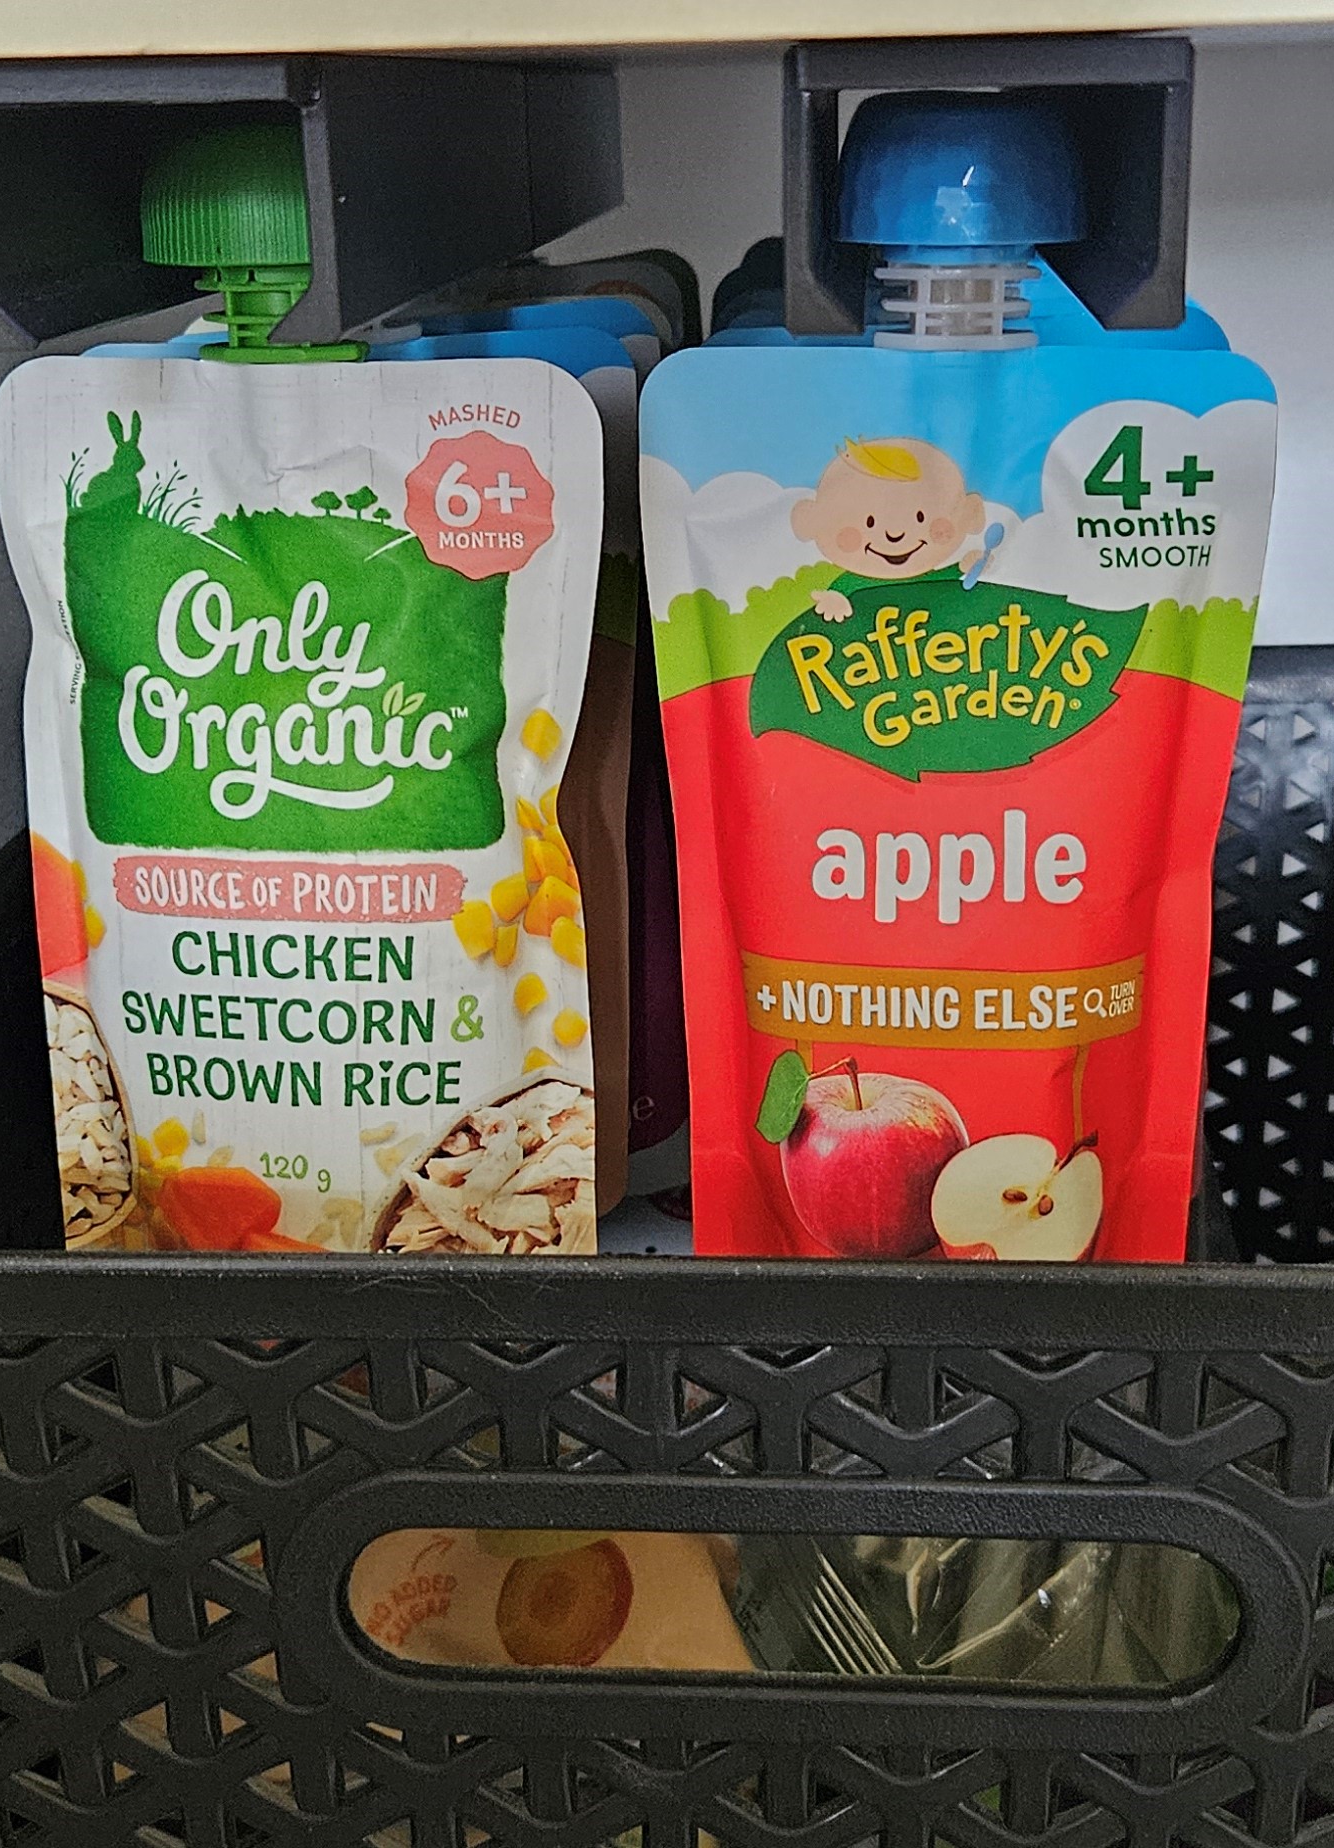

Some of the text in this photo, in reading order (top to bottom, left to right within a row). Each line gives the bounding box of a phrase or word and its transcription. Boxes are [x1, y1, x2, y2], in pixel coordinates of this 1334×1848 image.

[428, 403, 521, 431] MASHED
[1083, 425, 1214, 510] 4+
[435, 460, 528, 528] 6+
[438, 531, 524, 550] MONTHS
[1077, 508, 1217, 539] months
[1099, 544, 1211, 569] SMOOTH
[157, 569, 386, 708] Only
[785, 603, 1110, 715] Rafferty's
[70, 662, 82, 705] SERVING
[812, 809, 1087, 924] apple
[134, 865, 438, 915] SOURCE OF PROTEIN
[171, 930, 415, 983] CHICKEN
[973, 984, 1079, 1030] ELSE
[1108, 996, 1135, 1018] OVER
[1109, 978, 1136, 1000] TURN
[122, 990, 485, 1045] SWEETCORN &
[147, 1053, 323, 1106] BROWN
[259, 1152, 308, 1179] 120
[390, 1574, 458, 1604] ADDED
